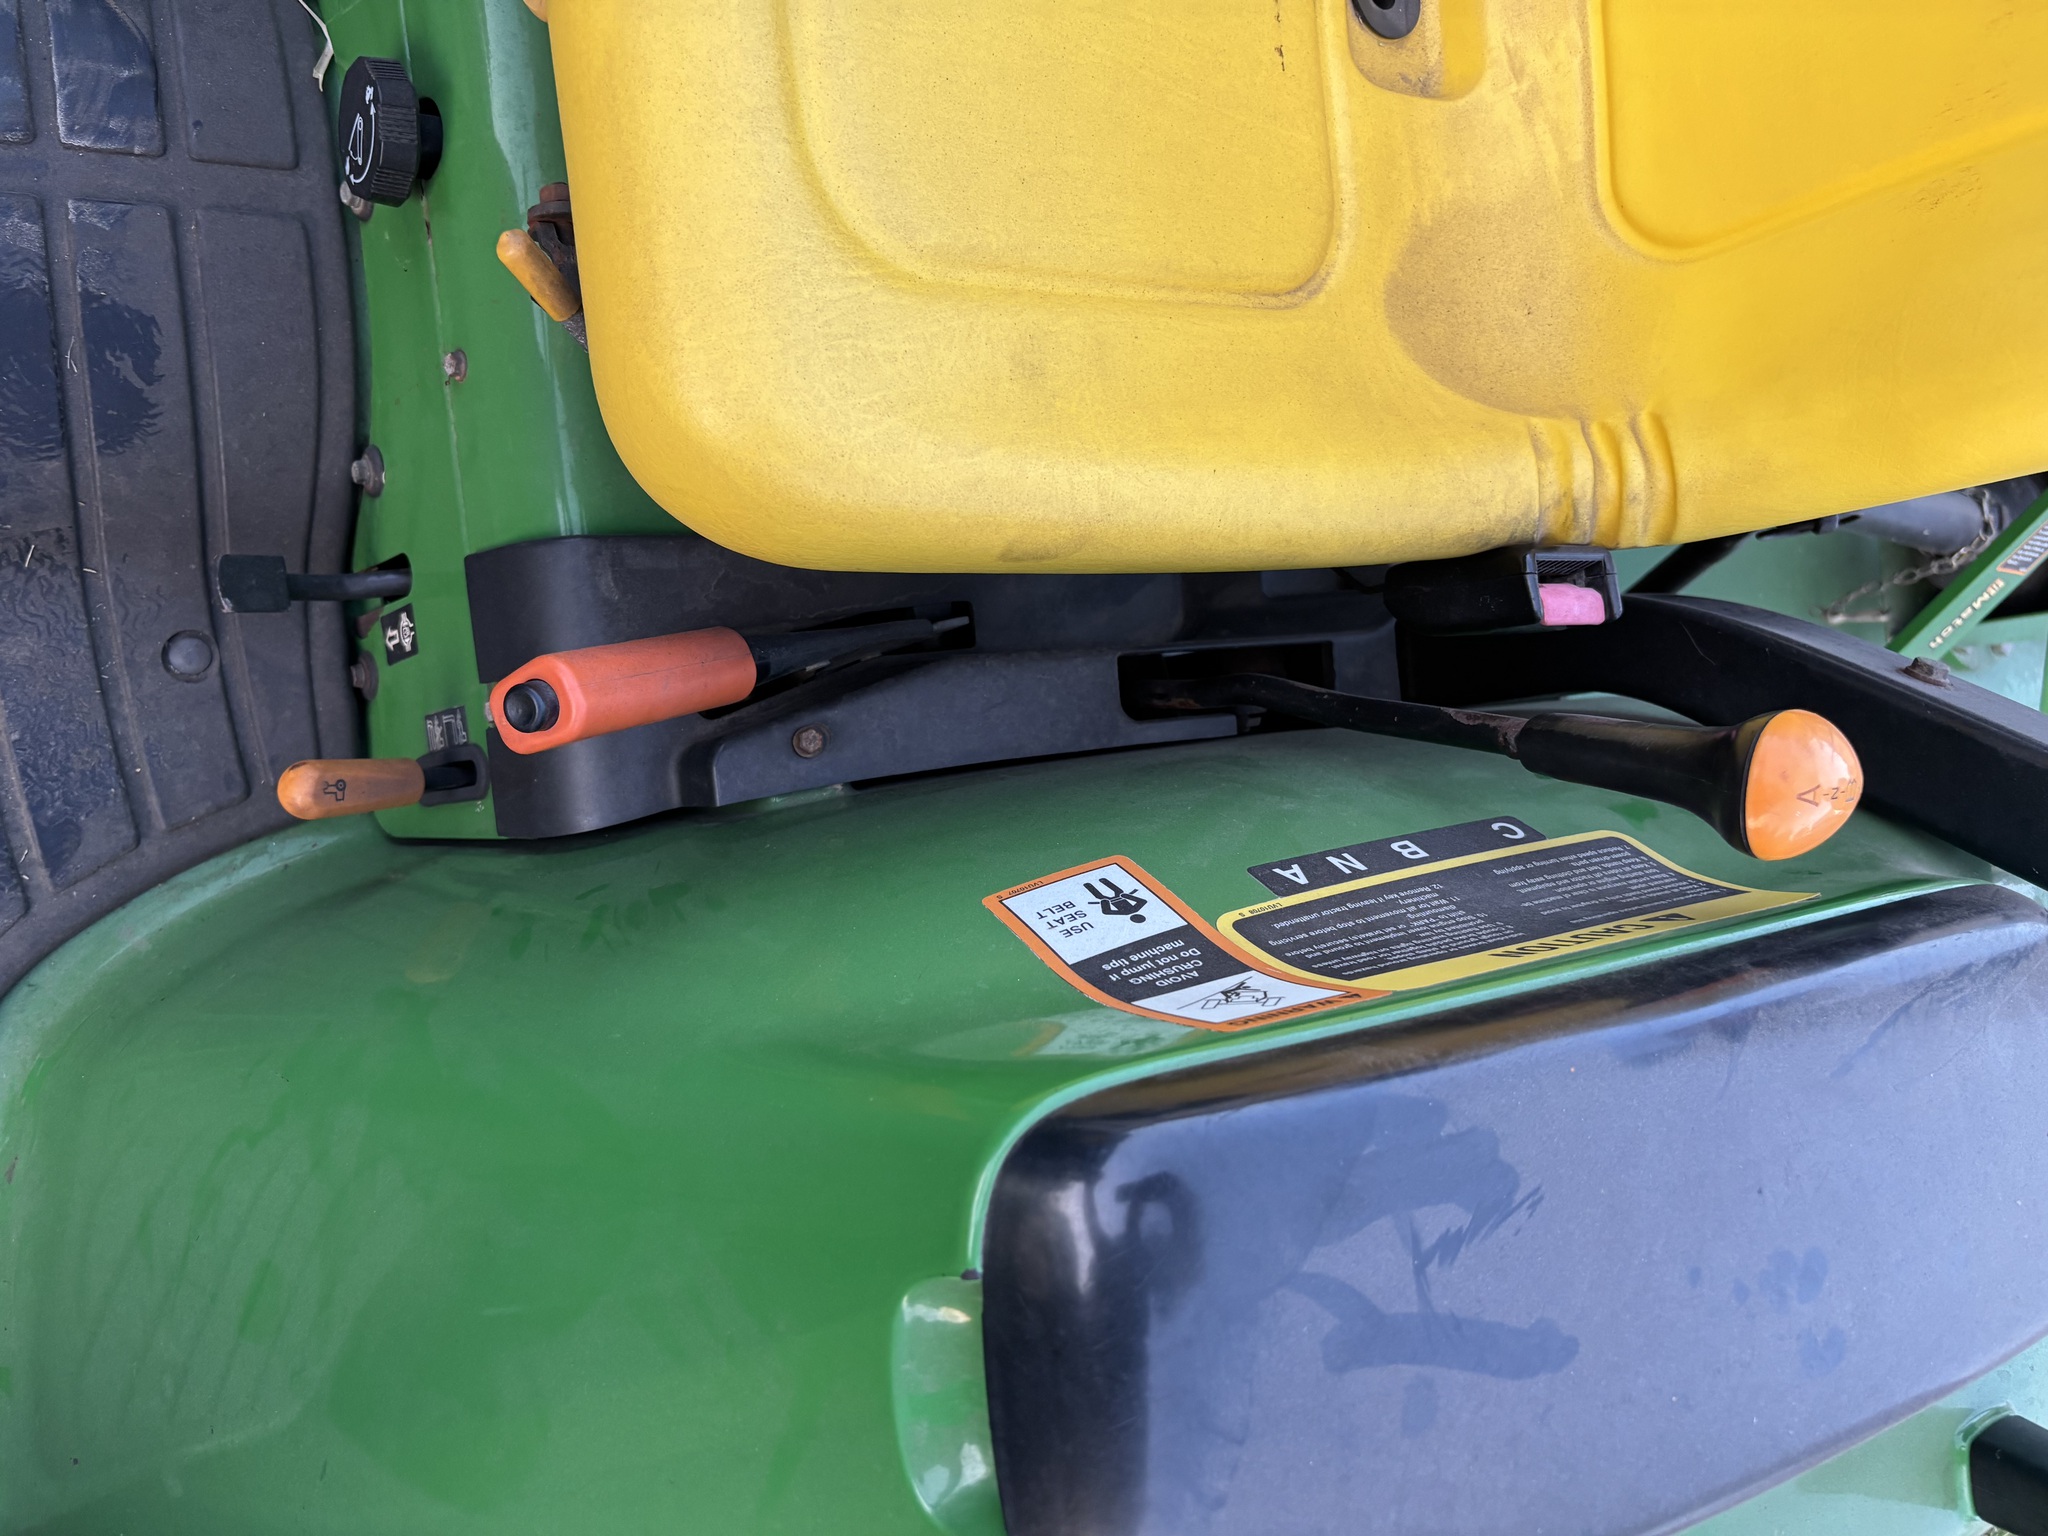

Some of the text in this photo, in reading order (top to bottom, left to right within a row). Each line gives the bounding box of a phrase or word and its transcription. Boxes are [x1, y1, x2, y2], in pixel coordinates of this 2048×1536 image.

[1271, 822, 1525, 885] C B N A
[1395, 891, 1439, 905] machinery.
[1397, 885, 1431, 897] Remove
[1036, 900, 1076, 920] BELT
[1319, 905, 1350, 916] tractor
[1346, 898, 1379, 909] leaving
[1428, 898, 1449, 907] Wait
[1046, 910, 1087, 930] SEAT
[1269, 912, 1321, 929] unattended.
[1364, 908, 1407, 922] movement
[1059, 921, 1094, 938] USE
[1307, 925, 1338, 936] before
[1333, 920, 1356, 929] stop
[1266, 932, 1308, 945] servicing
[1489, 923, 1653, 957] CAUTION
[1102, 939, 1185, 971] machine tips
[1109, 948, 1202, 981] Do not jump if
[1128, 959, 1203, 985] CRUSHING
[1155, 970, 1199, 987] AVOID
